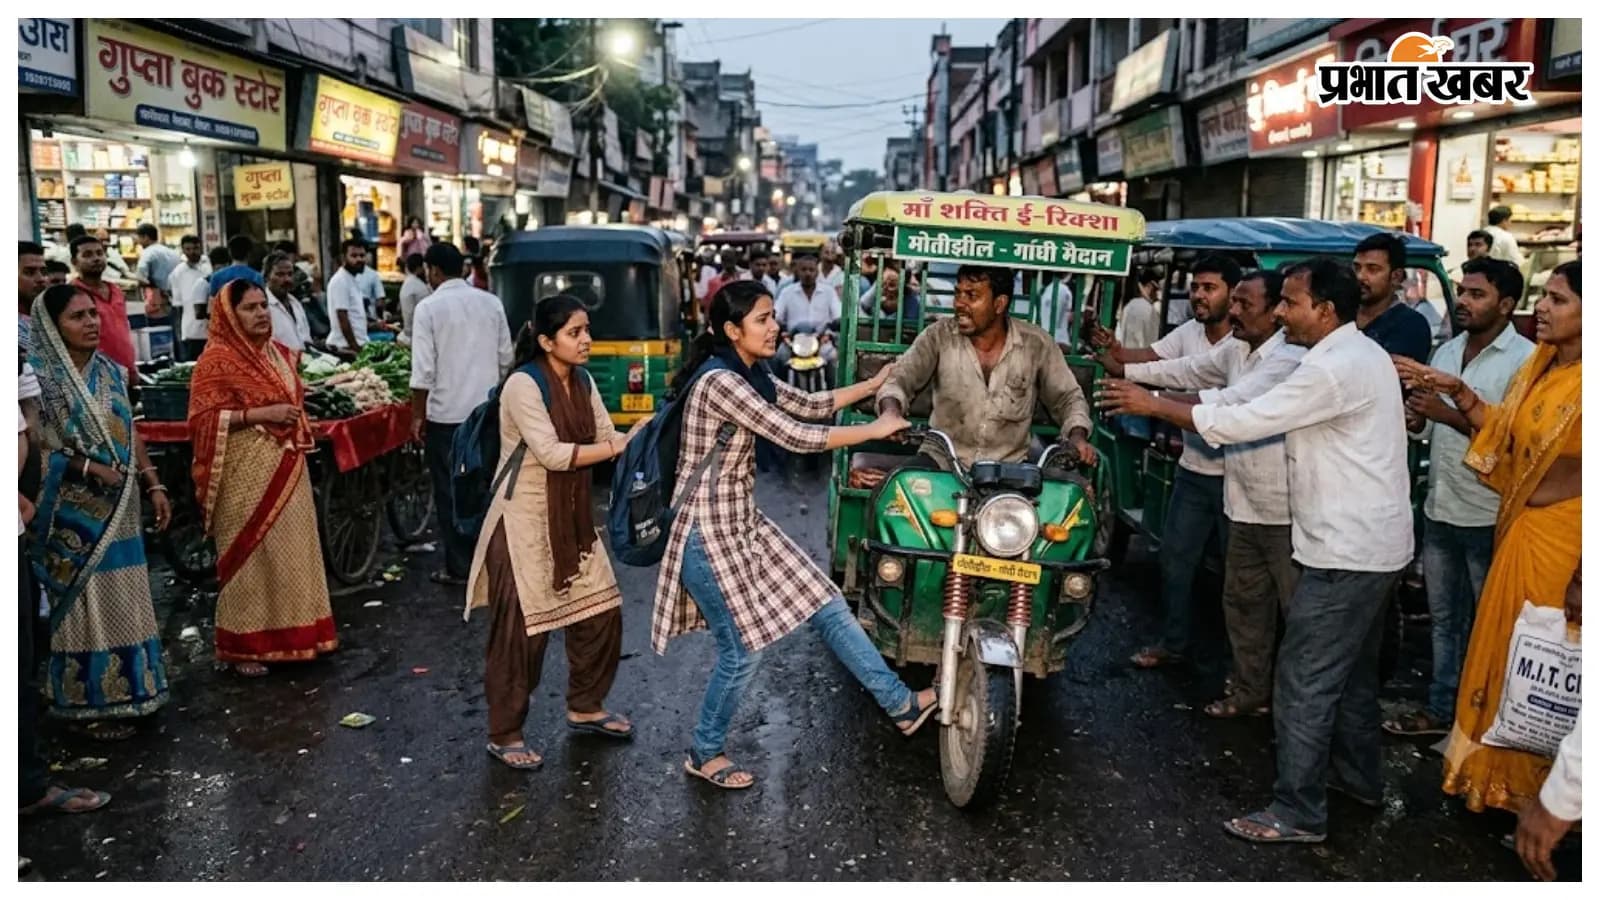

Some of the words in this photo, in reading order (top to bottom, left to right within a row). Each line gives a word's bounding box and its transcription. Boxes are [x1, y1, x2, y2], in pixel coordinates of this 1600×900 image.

[97, 35, 174, 96] गुप्ता
[181, 59, 228, 110] बुक
[233, 68, 283, 113] स्टोर
[902, 196, 934, 219] माँ
[940, 198, 1010, 223] शक्ति
[1016, 202, 1118, 232] ई-रिक्शा
[908, 230, 996, 258] मोतीझील
[1062, 241, 1115, 267] मैदान
[1516, 656, 1560, 689] M.I.T.
